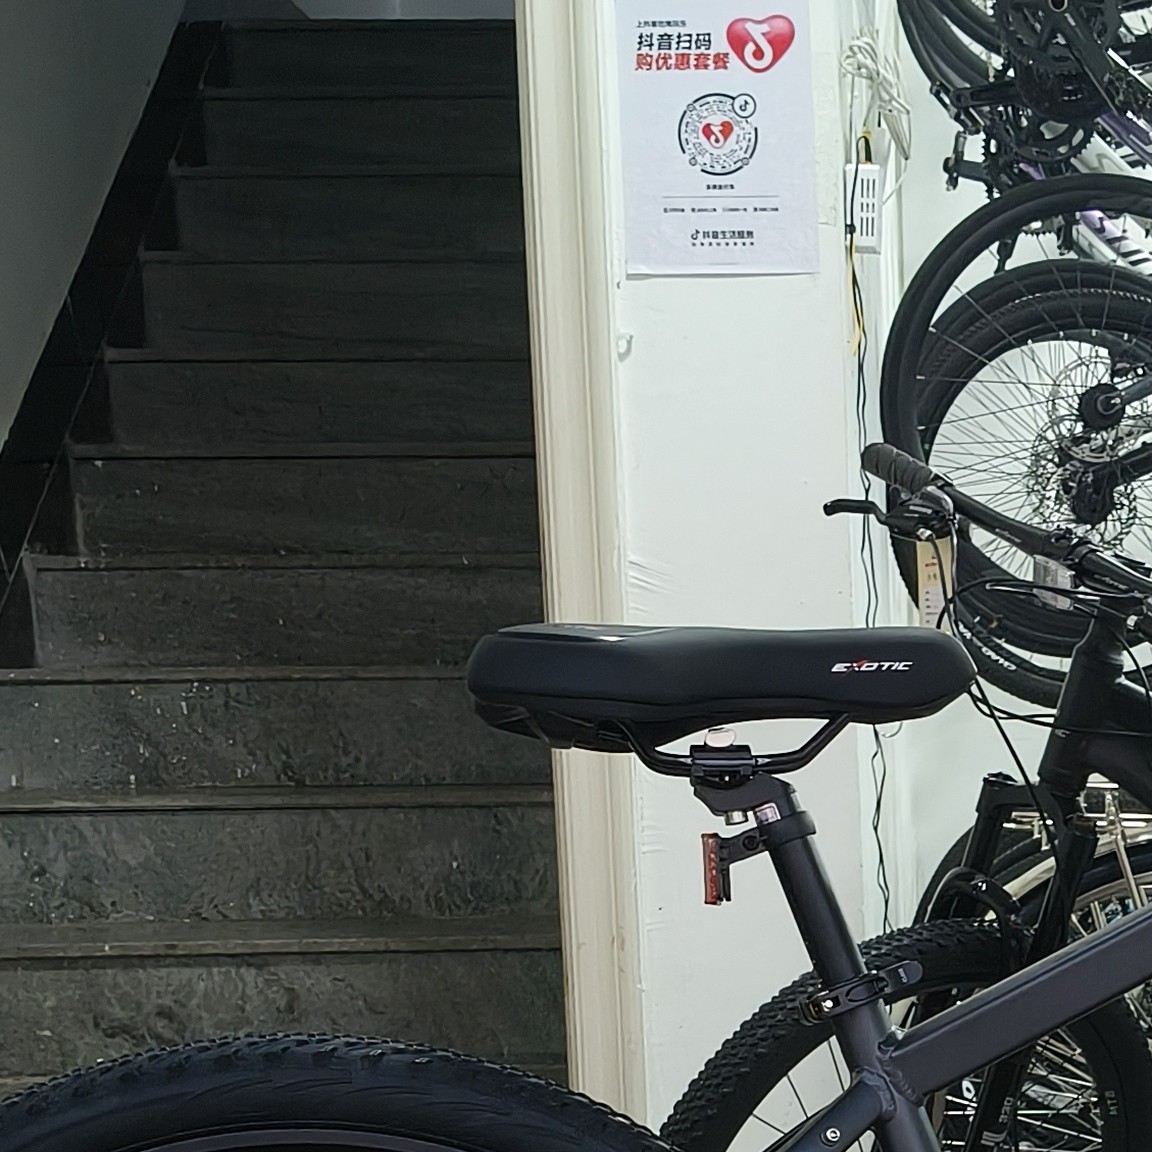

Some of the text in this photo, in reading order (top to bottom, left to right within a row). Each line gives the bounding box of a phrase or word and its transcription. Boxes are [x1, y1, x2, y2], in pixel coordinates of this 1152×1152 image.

[637, 32, 712, 51] 抖音扫码
[635, 52, 730, 71] 购优惠套餐
[831, 659, 913, 674] EXOTIC
